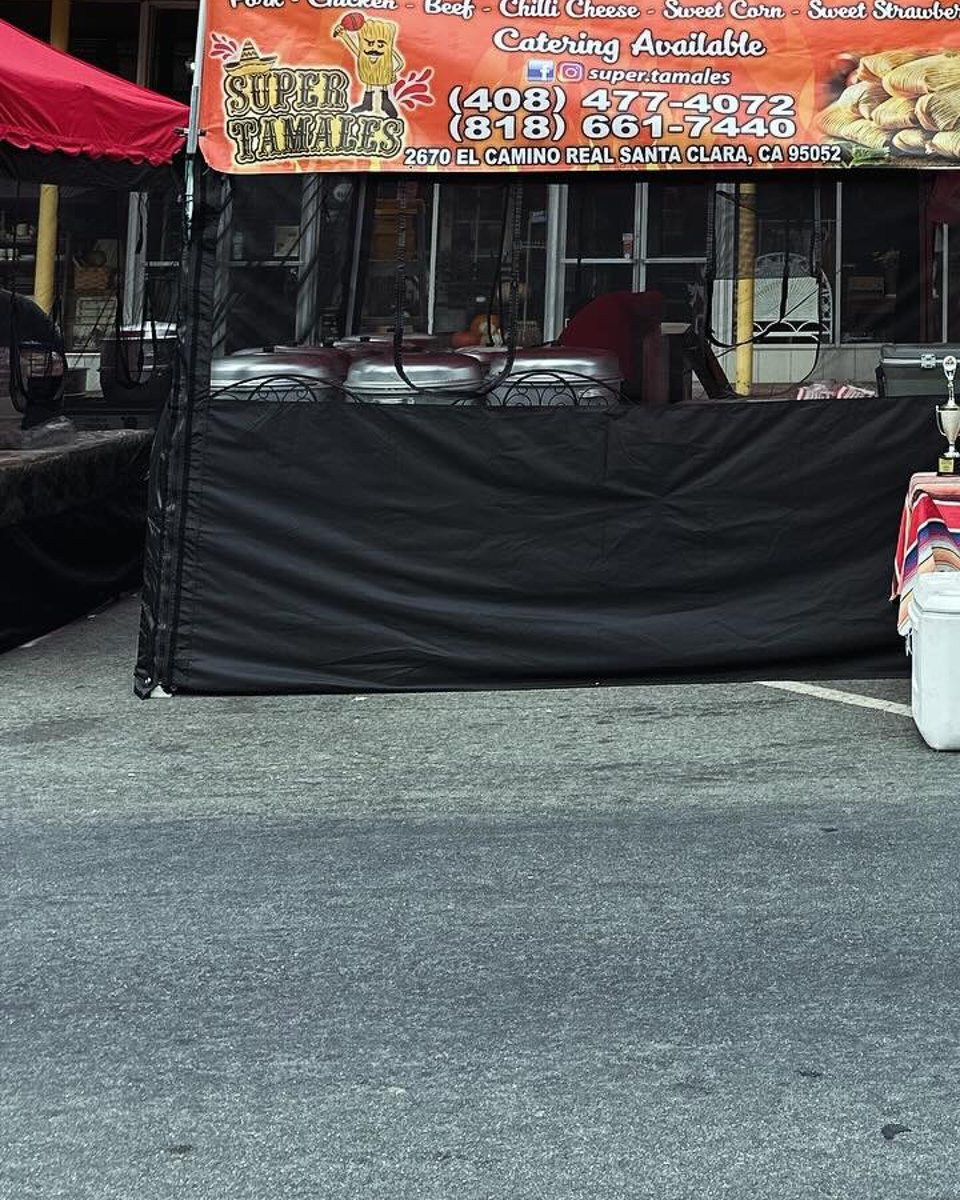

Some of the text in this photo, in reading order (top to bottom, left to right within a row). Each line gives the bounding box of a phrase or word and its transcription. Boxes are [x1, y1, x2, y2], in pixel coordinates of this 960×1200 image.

[729, 0, 785, 21] Corn
[806, 0, 868, 21] Sweet
[492, 26, 767, 64] Catering Available
[588, 66, 731, 87] super.tamales
[224, 68, 350, 115] SUPER
[448, 86, 796, 116] (408) 477-4072
[227, 112, 405, 165] TAMALES
[448, 114, 796, 142] (818) 661-7440
[404, 144, 842, 166] 2670 EL CAMINO REAL SANTA CLARA, CA 95052
